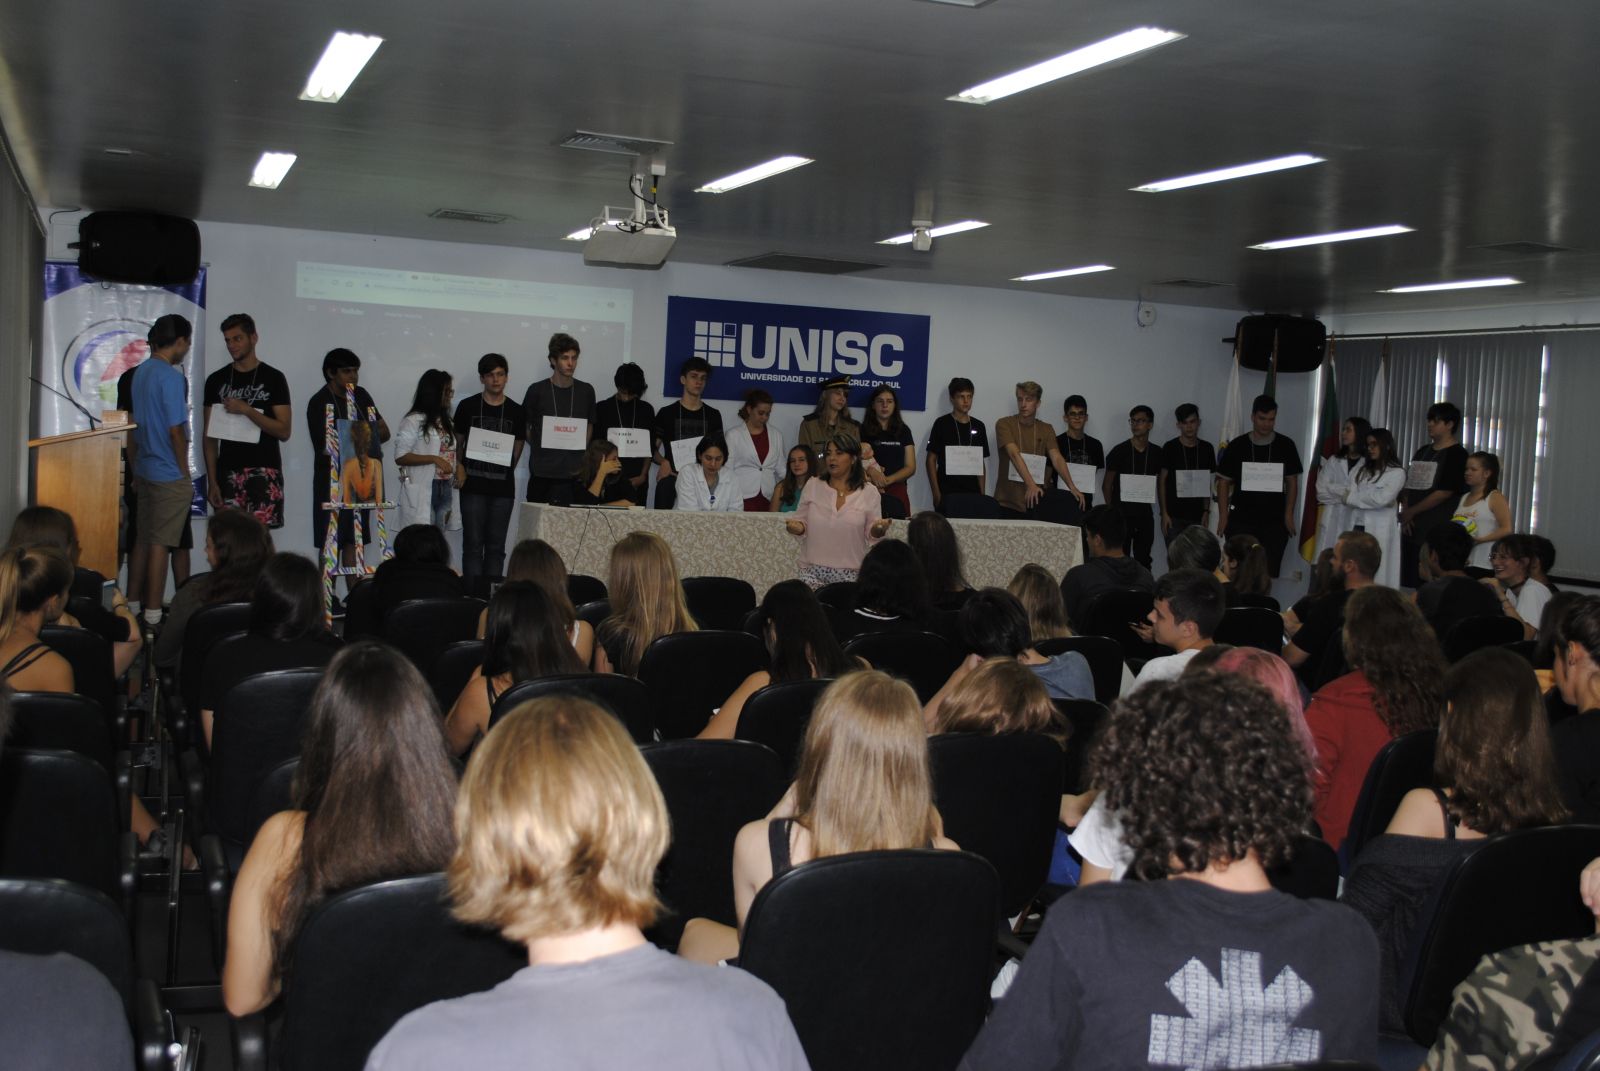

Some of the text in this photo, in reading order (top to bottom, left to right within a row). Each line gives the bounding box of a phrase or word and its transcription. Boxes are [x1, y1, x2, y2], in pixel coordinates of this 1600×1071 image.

[740, 323, 904, 377] UNISC
[740, 372, 803, 384] UNIVERSIDADE
[805, 376, 817, 384] DE
[848, 379, 870, 387] CRUZ
